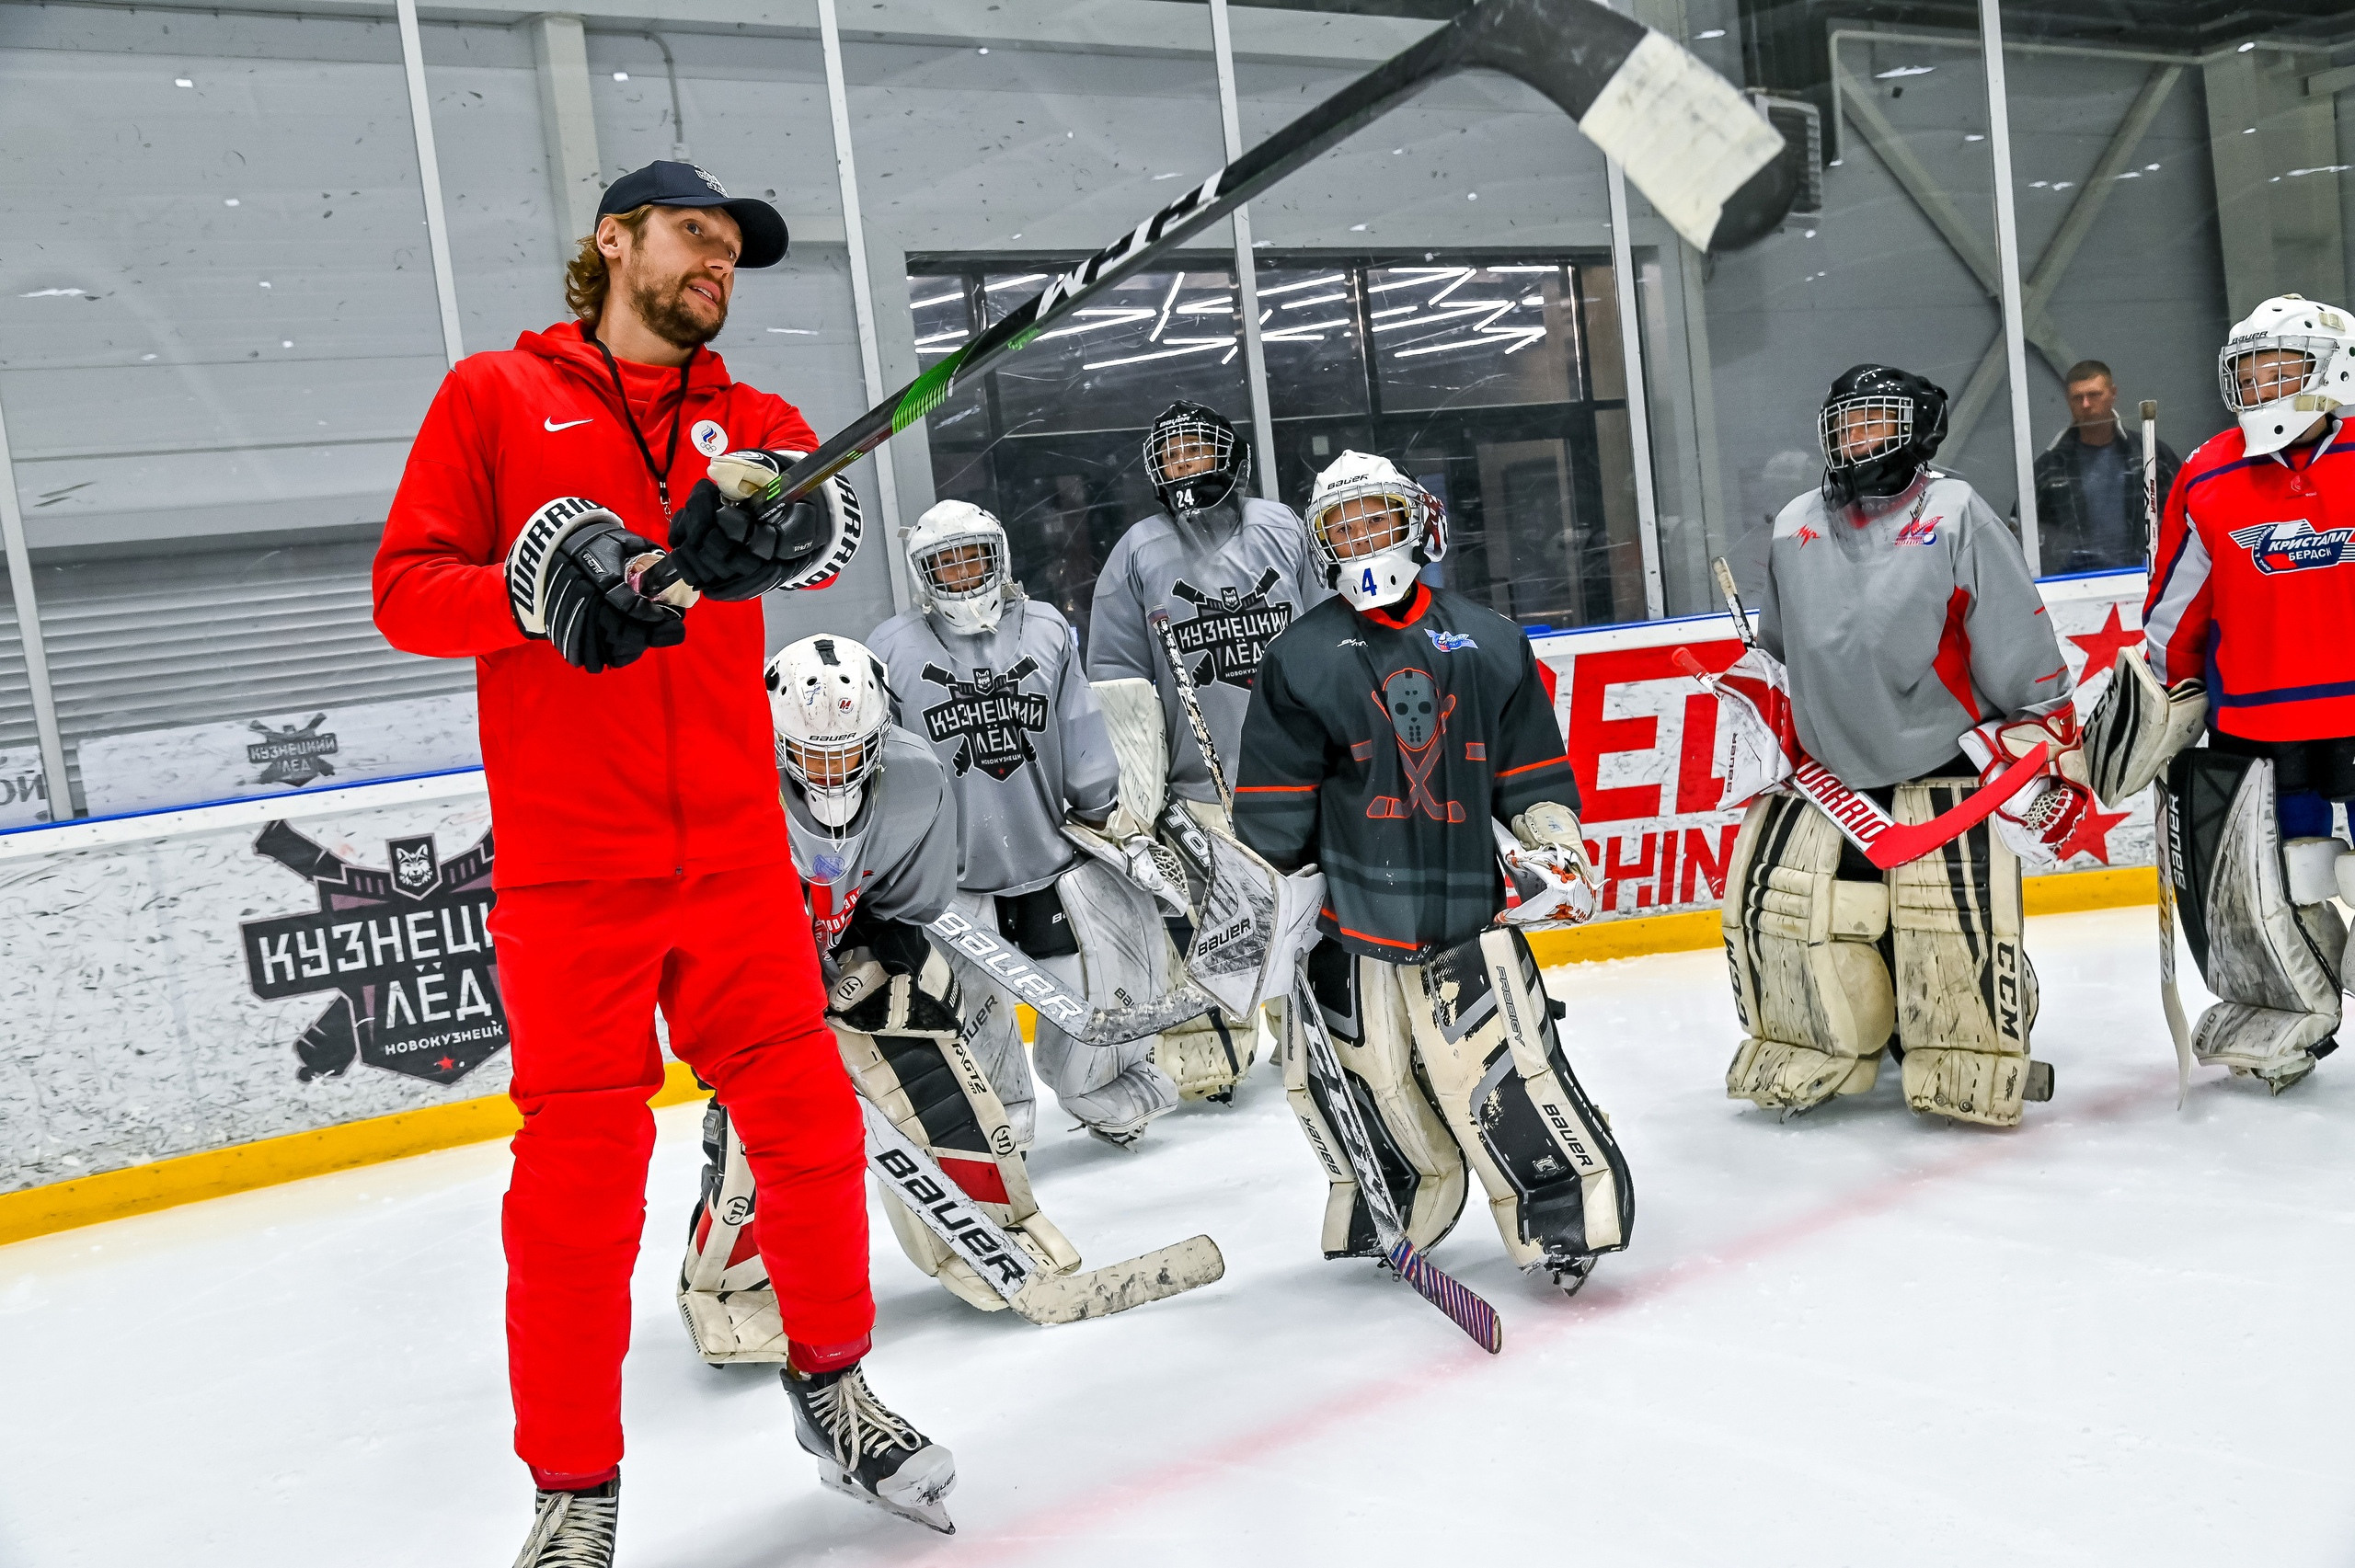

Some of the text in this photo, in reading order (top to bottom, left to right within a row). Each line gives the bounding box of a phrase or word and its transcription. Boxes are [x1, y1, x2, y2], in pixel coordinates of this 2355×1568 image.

[2232, 330, 2268, 344] BAUER
[1177, 488, 1194, 508] 24
[1327, 474, 1369, 490] BAUER
[2268, 532, 2348, 552] КРИСТАЛЛ
[2288, 547, 2332, 561] БЕРДСК
[1361, 567, 1377, 597] 4
[1178, 605, 1288, 649] КУЗНЕЦКИЙ
[809, 732, 856, 741] BAUER
[976, 724, 1017, 753] ЛЁД
[1726, 732, 1738, 794] BAUER
[2168, 793, 2187, 890] BAUER
[1198, 917, 1251, 956] BAUER
[935, 911, 1085, 1022] BAUER
[1724, 933, 1748, 1027] CCM
[385, 962, 492, 1029] ЛЁД
[1496, 965, 1525, 1047] PRODIGY
[1996, 941, 2020, 1041] CCM
[385, 1024, 504, 1056] НОВОКУЗНЕЦК
[1299, 1115, 1342, 1175] BAUER
[1541, 1104, 1592, 1167] BAUER
[875, 1149, 1026, 1285] BAUER
